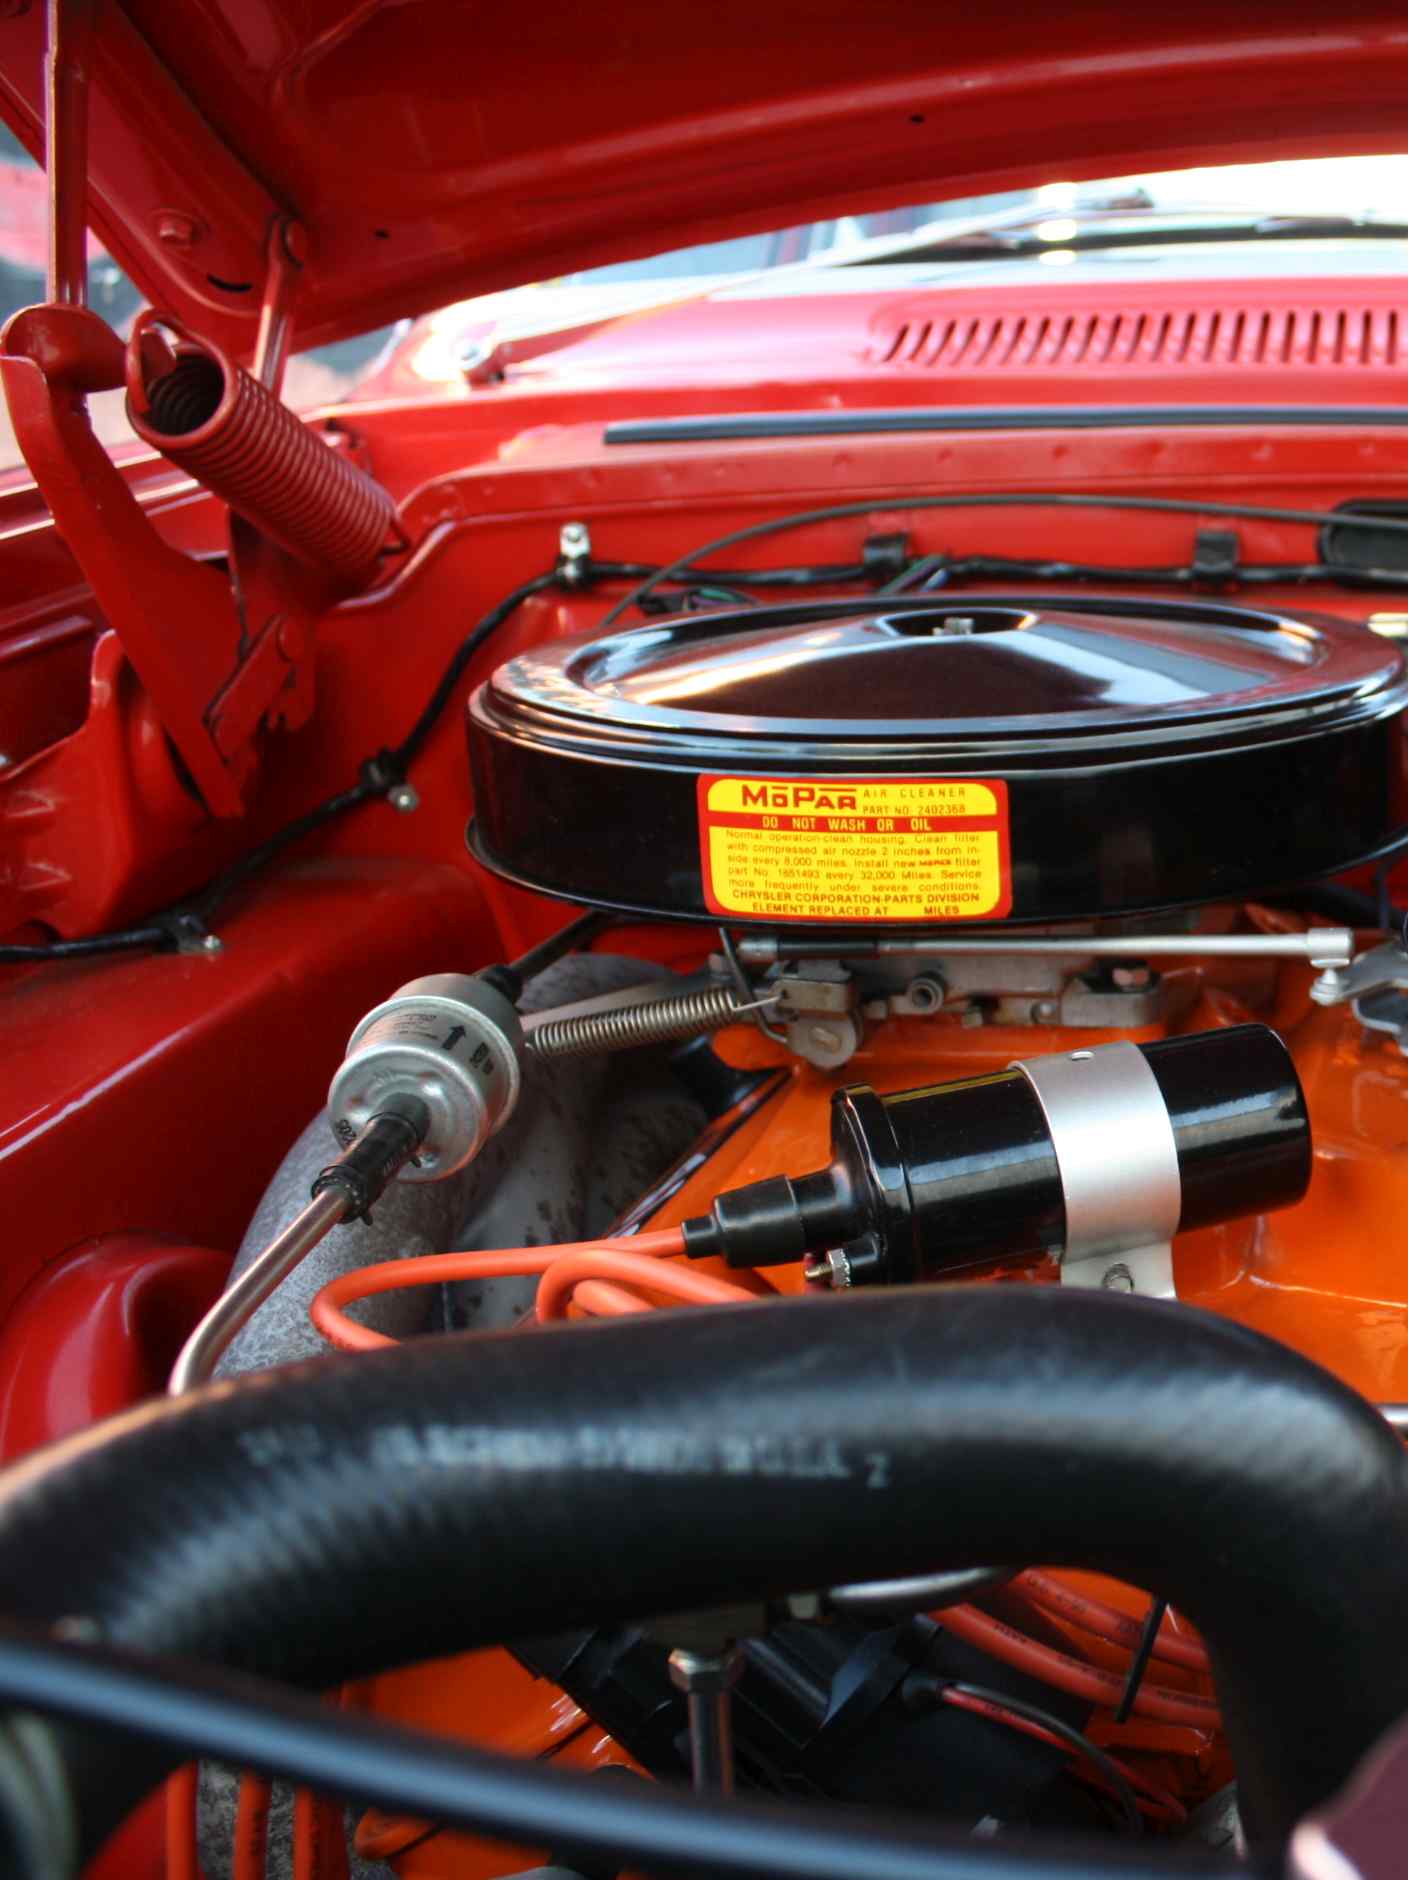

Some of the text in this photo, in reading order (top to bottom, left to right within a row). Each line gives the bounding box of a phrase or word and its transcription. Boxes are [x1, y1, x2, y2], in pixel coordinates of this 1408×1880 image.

[863, 787, 966, 799] AIR CLEANER
[862, 804, 889, 815] PART
[761, 815, 932, 832] DO NOT WASH OR OIL
[732, 889, 792, 900] CHRYSLER
[927, 892, 980, 904] DIVISION
[752, 902, 960, 915] ELEMENT REPLACED AT MILES
